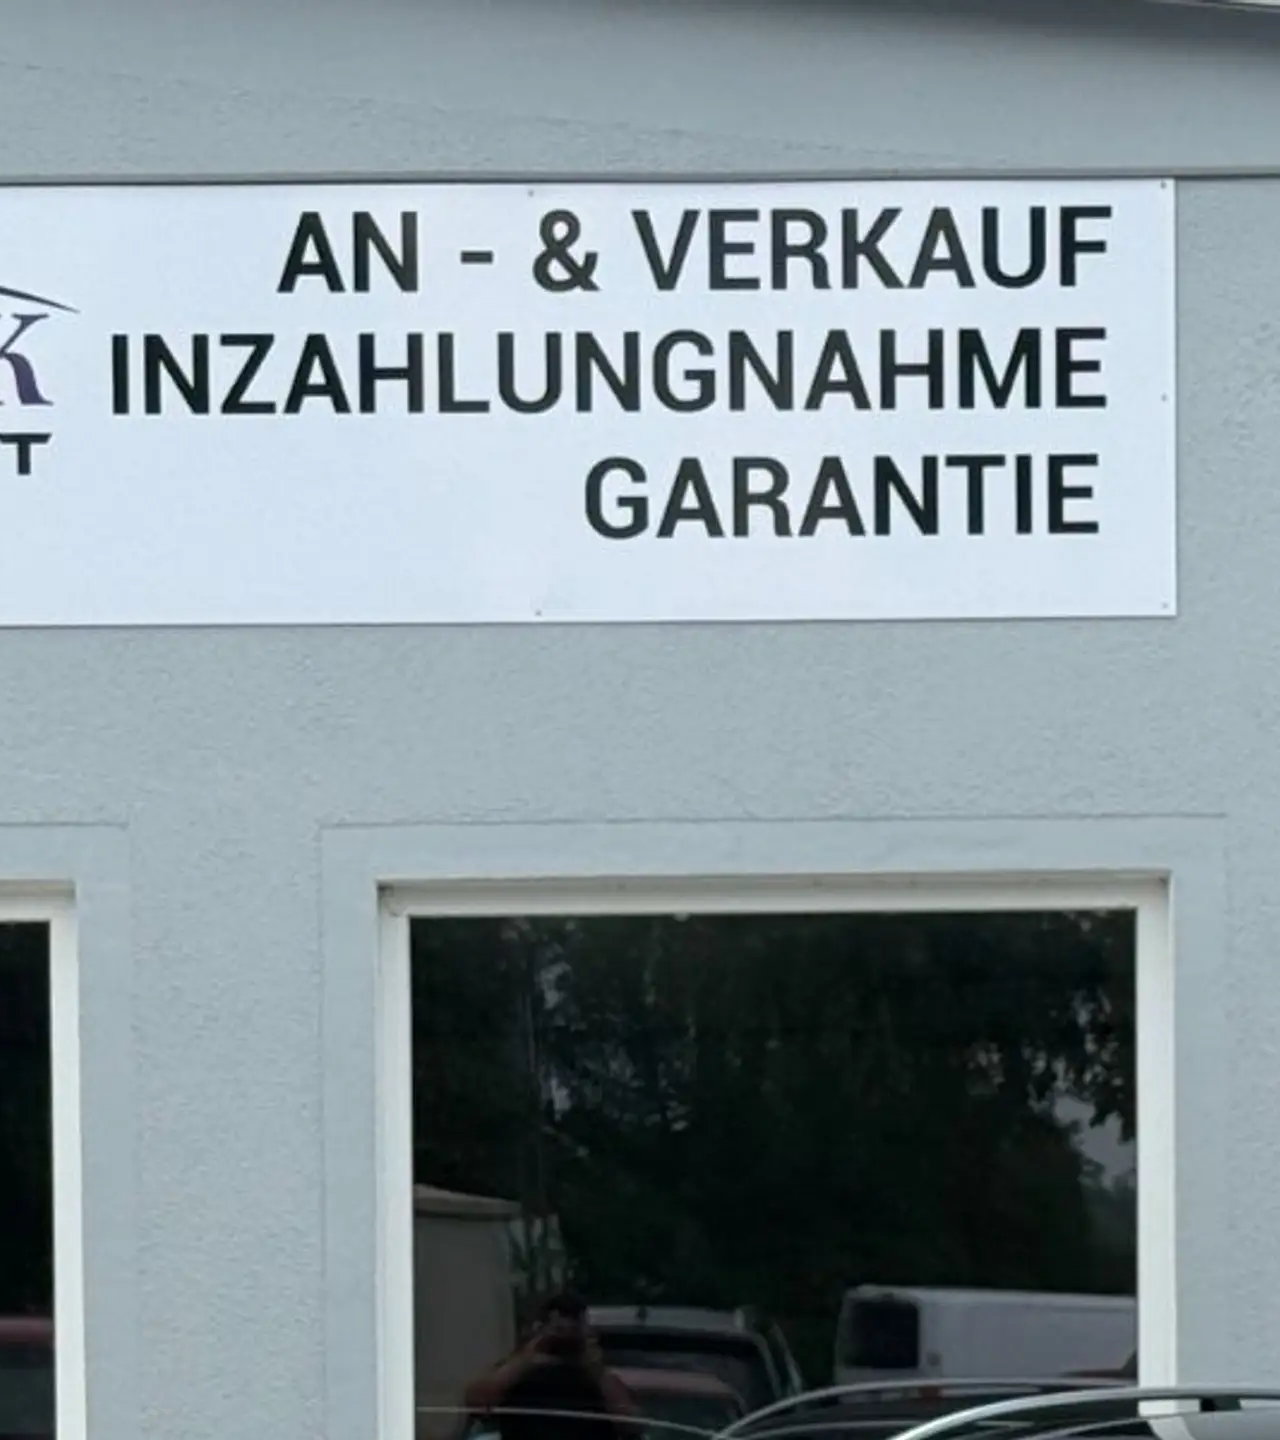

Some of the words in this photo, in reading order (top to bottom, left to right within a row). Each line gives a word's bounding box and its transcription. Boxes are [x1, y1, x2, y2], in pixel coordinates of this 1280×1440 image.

[276, 211, 418, 294] AN
[460, 250, 494, 264] -
[532, 209, 600, 293] &
[631, 205, 1112, 291] VERKAUF
[111, 327, 1107, 415] INZAHLUNGNAHME
[584, 453, 1099, 540] GARANTIE
